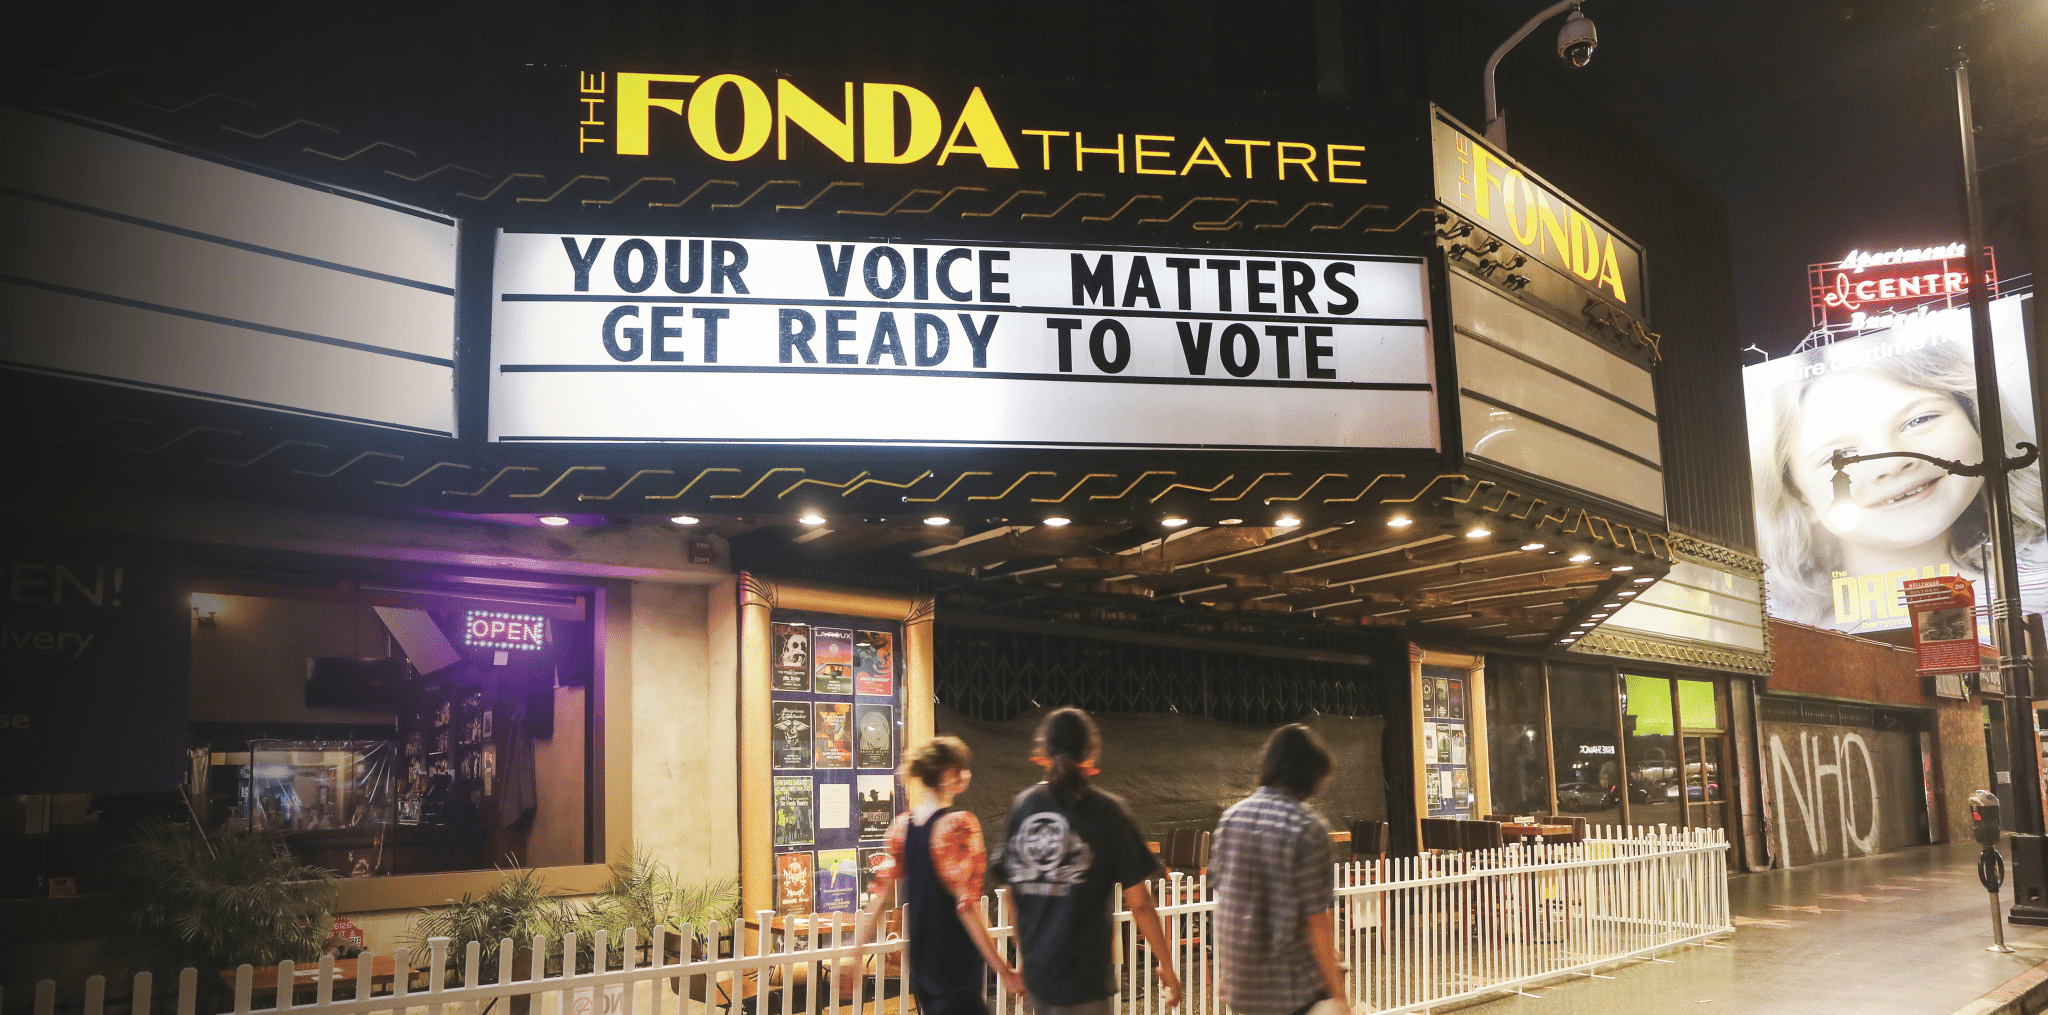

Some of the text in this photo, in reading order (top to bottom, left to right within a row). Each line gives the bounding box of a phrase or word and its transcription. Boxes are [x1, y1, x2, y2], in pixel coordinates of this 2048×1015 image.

[580, 71, 1368, 184] THE FONDA THEATRE
[1455, 131, 1627, 304] THE FONDA
[1839, 242, 1967, 273] Apartments
[560, 236, 1359, 315] YOUR VOICE MATTERS
[1856, 271, 1988, 301] CENTR
[601, 305, 1337, 379] GET READY TO VOTE
[1831, 569, 1848, 579] the
[1953, 582, 1965, 590] 20
[472, 619, 538, 641] OPEN
[1862, 618, 1912, 629] barrymor
[333, 922, 352, 930] 6126
